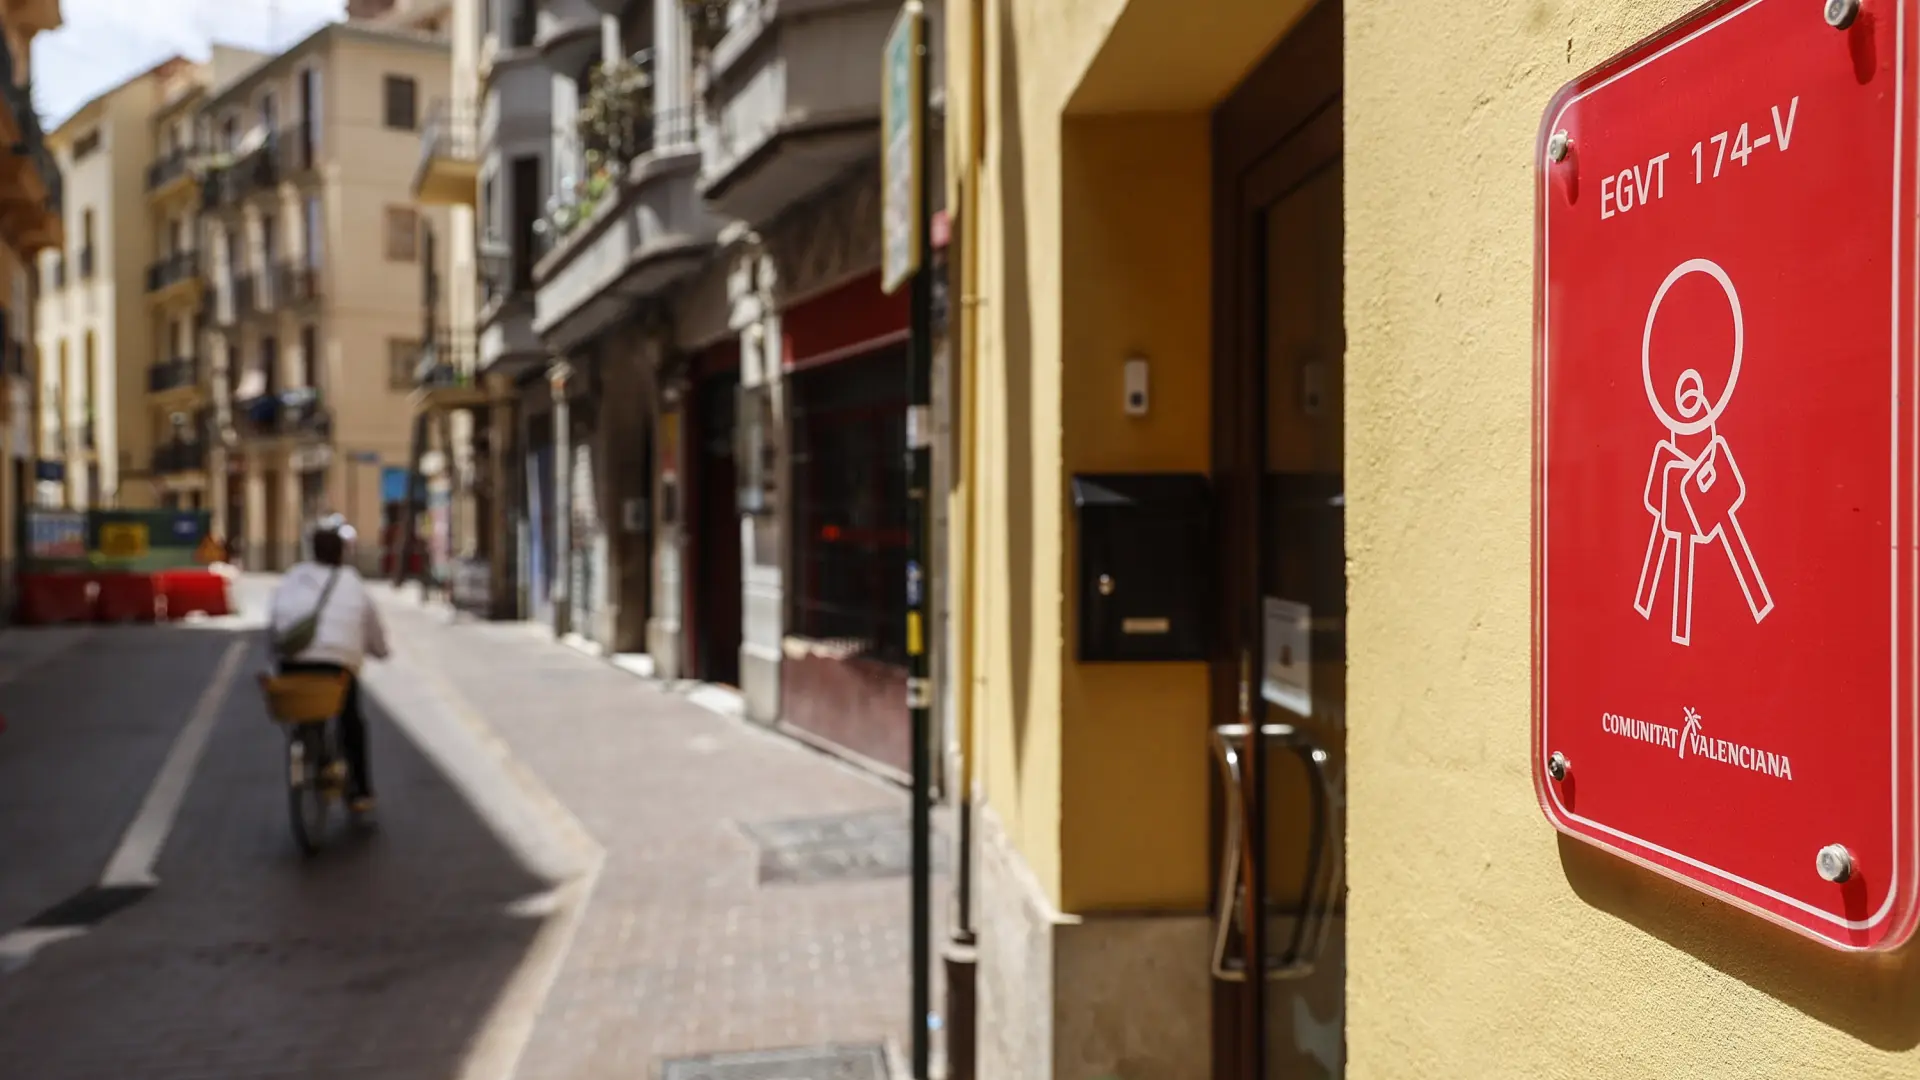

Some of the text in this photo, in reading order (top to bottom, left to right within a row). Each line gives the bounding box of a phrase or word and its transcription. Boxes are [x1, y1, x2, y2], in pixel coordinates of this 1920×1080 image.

[1600, 96, 1799, 220] EGVT 174-V
[1602, 712, 1792, 780] COMUNITAT VALENCIANA
